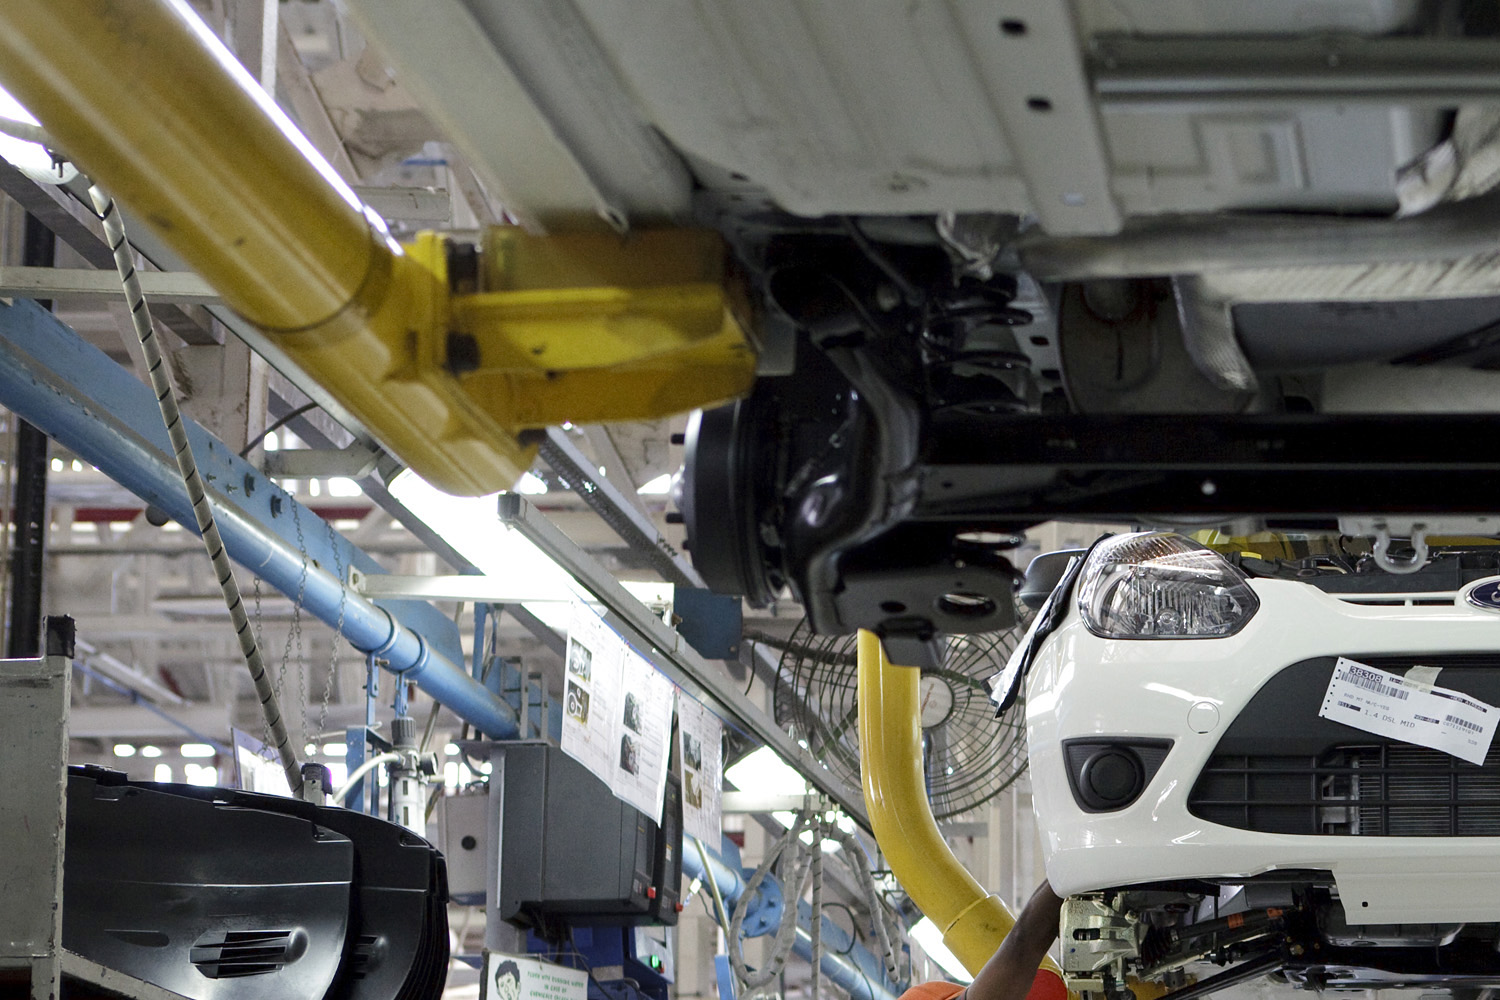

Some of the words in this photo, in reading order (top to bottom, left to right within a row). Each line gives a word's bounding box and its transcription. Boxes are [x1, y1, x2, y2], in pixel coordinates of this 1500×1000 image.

[1350, 667, 1383, 683] 38308
[1364, 709, 1379, 719] 1.4
[1382, 713, 1396, 724] DSL
[1401, 719, 1416, 729] MID
